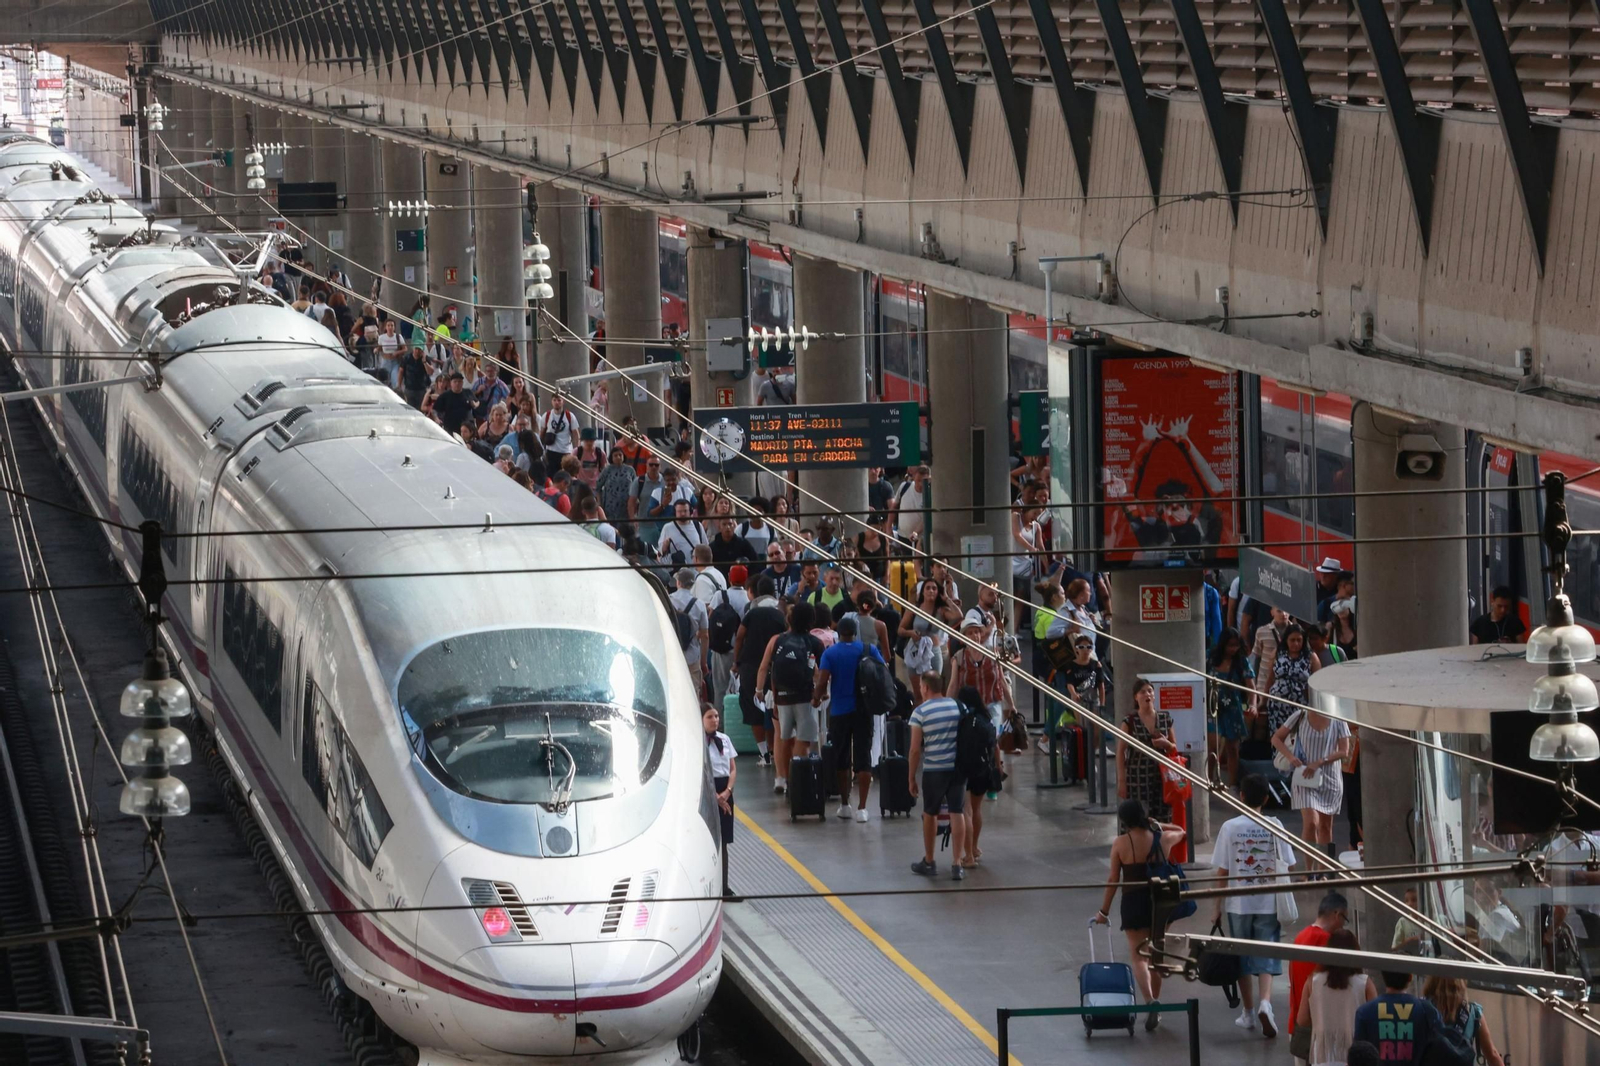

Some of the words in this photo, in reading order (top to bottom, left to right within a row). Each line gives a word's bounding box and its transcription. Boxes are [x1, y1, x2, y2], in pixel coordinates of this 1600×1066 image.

[398, 240, 404, 251] 3
[1133, 361, 1168, 370] AGENDA
[1171, 360, 1190, 369] 1999
[750, 420, 781, 431] 11:37
[787, 418, 843, 430] AVE-02111
[750, 440, 788, 451] MADRID
[794, 439, 818, 450] PTA.
[825, 438, 863, 448] ATOCHA
[886, 435, 900, 460] 3
[762, 453, 789, 463] PARA
[794, 452, 807, 462] EN
[1258, 566, 1271, 589] Sevilla
[1270, 572, 1282, 594] Santa
[1281, 576, 1292, 598] Justa
[1378, 1002, 1414, 1020] LV
[1379, 1021, 1414, 1040] RM
[1380, 1041, 1414, 1061] RN
